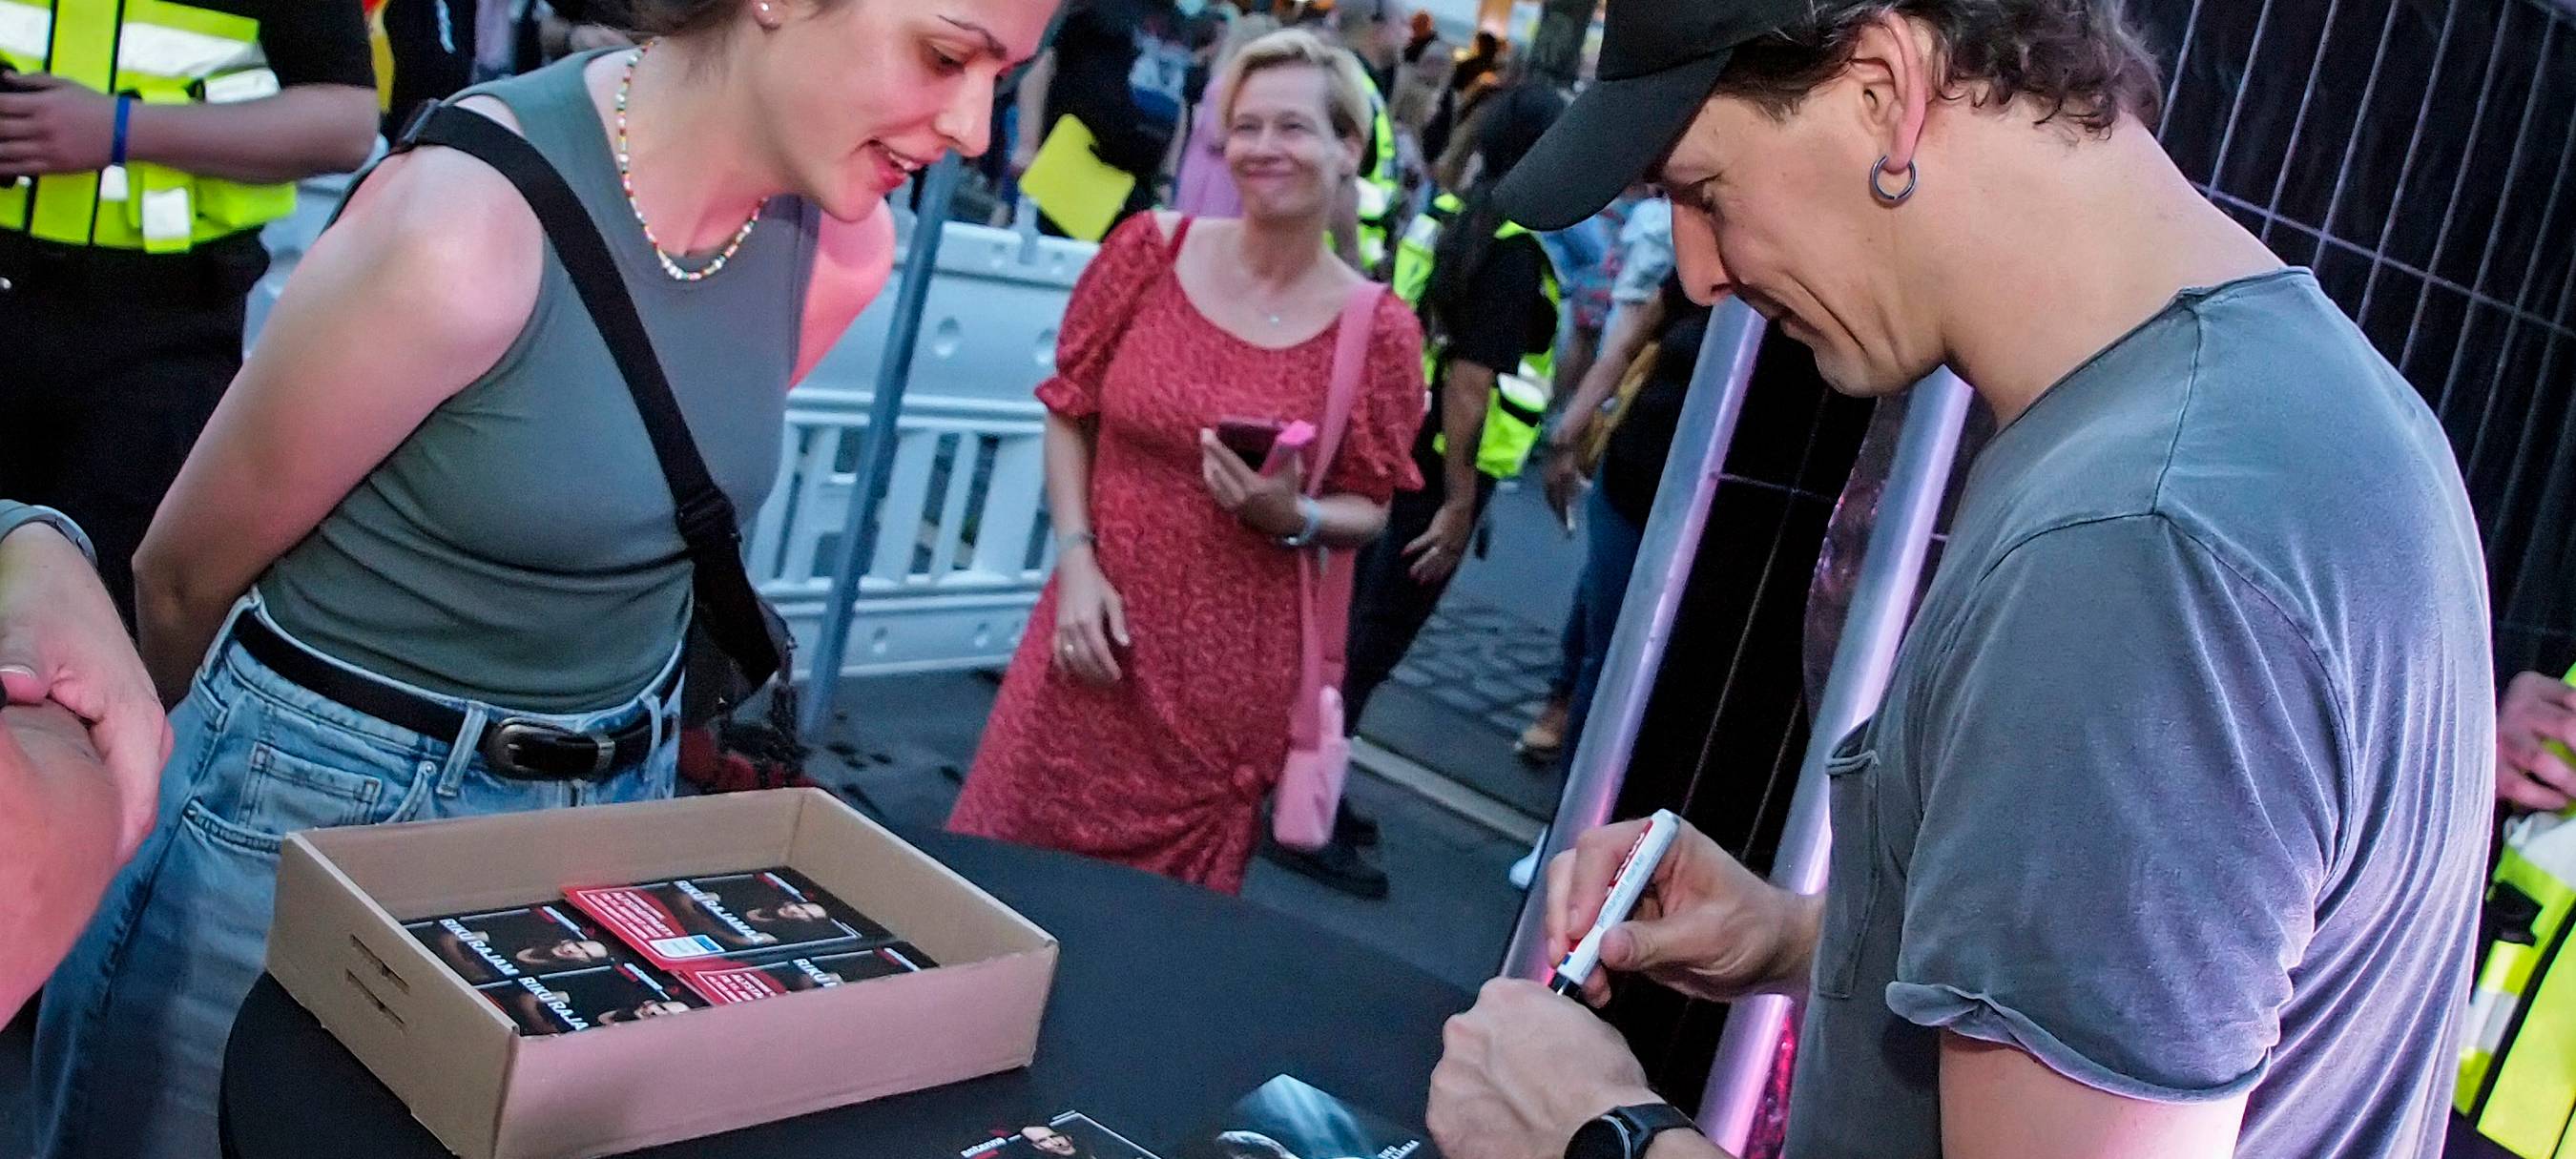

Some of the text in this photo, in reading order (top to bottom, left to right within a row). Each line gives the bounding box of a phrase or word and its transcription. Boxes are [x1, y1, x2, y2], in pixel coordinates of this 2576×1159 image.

[674, 880, 708, 902] RIKU
[701, 900, 763, 944] RAJAMAA
[439, 918, 475, 942] RIKU
[793, 958, 831, 983] RIKU
[518, 976, 556, 1002] RIKU
